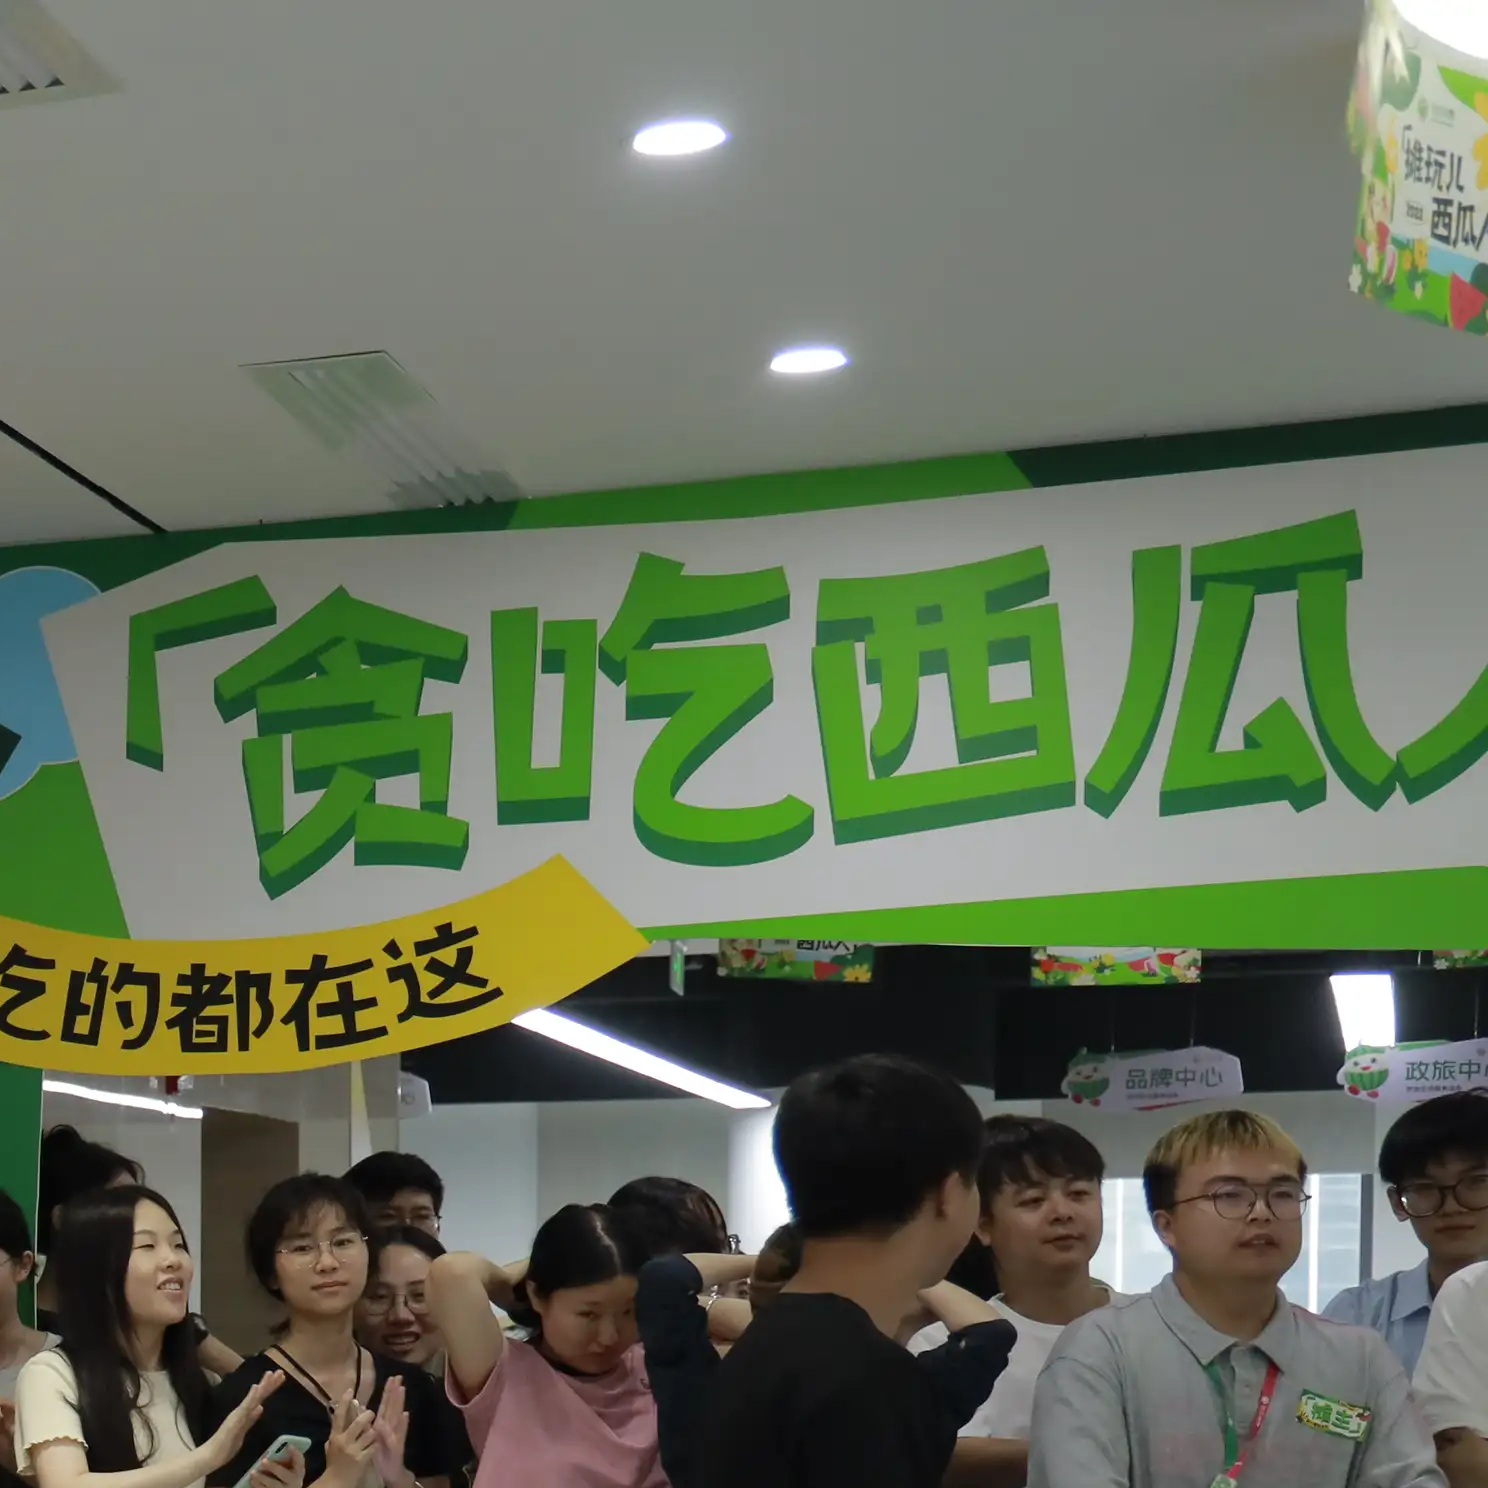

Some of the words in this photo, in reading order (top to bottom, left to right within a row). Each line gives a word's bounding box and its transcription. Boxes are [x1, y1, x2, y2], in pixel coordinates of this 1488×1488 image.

[1126, 1066, 1224, 1090] 品牌中心
[1405, 1059, 1488, 1082] 政旅中
